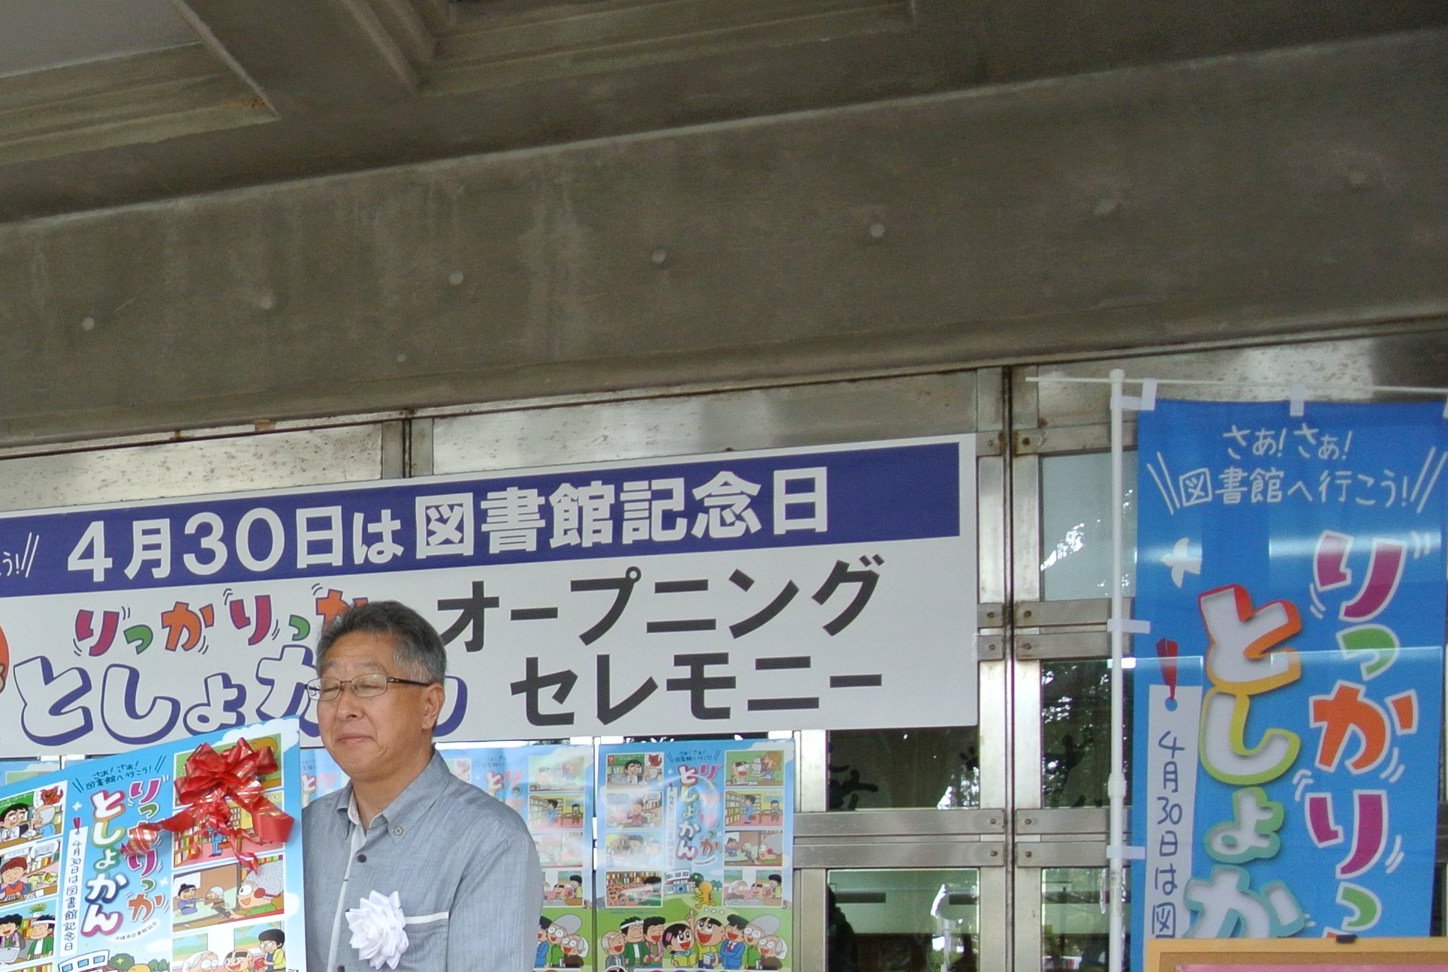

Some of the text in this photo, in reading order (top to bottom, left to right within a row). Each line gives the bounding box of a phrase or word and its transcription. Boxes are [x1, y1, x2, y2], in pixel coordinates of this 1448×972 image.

[67, 466, 829, 582] 4月30日は図書館記念日
[1179, 465, 1409, 506] 図書館へ行こう!
[437, 553, 885, 652] オープニング
[510, 652, 883, 726] セレモニー
[1304, 530, 1418, 938] りっかりっ
[81, 789, 129, 938] としょかん
